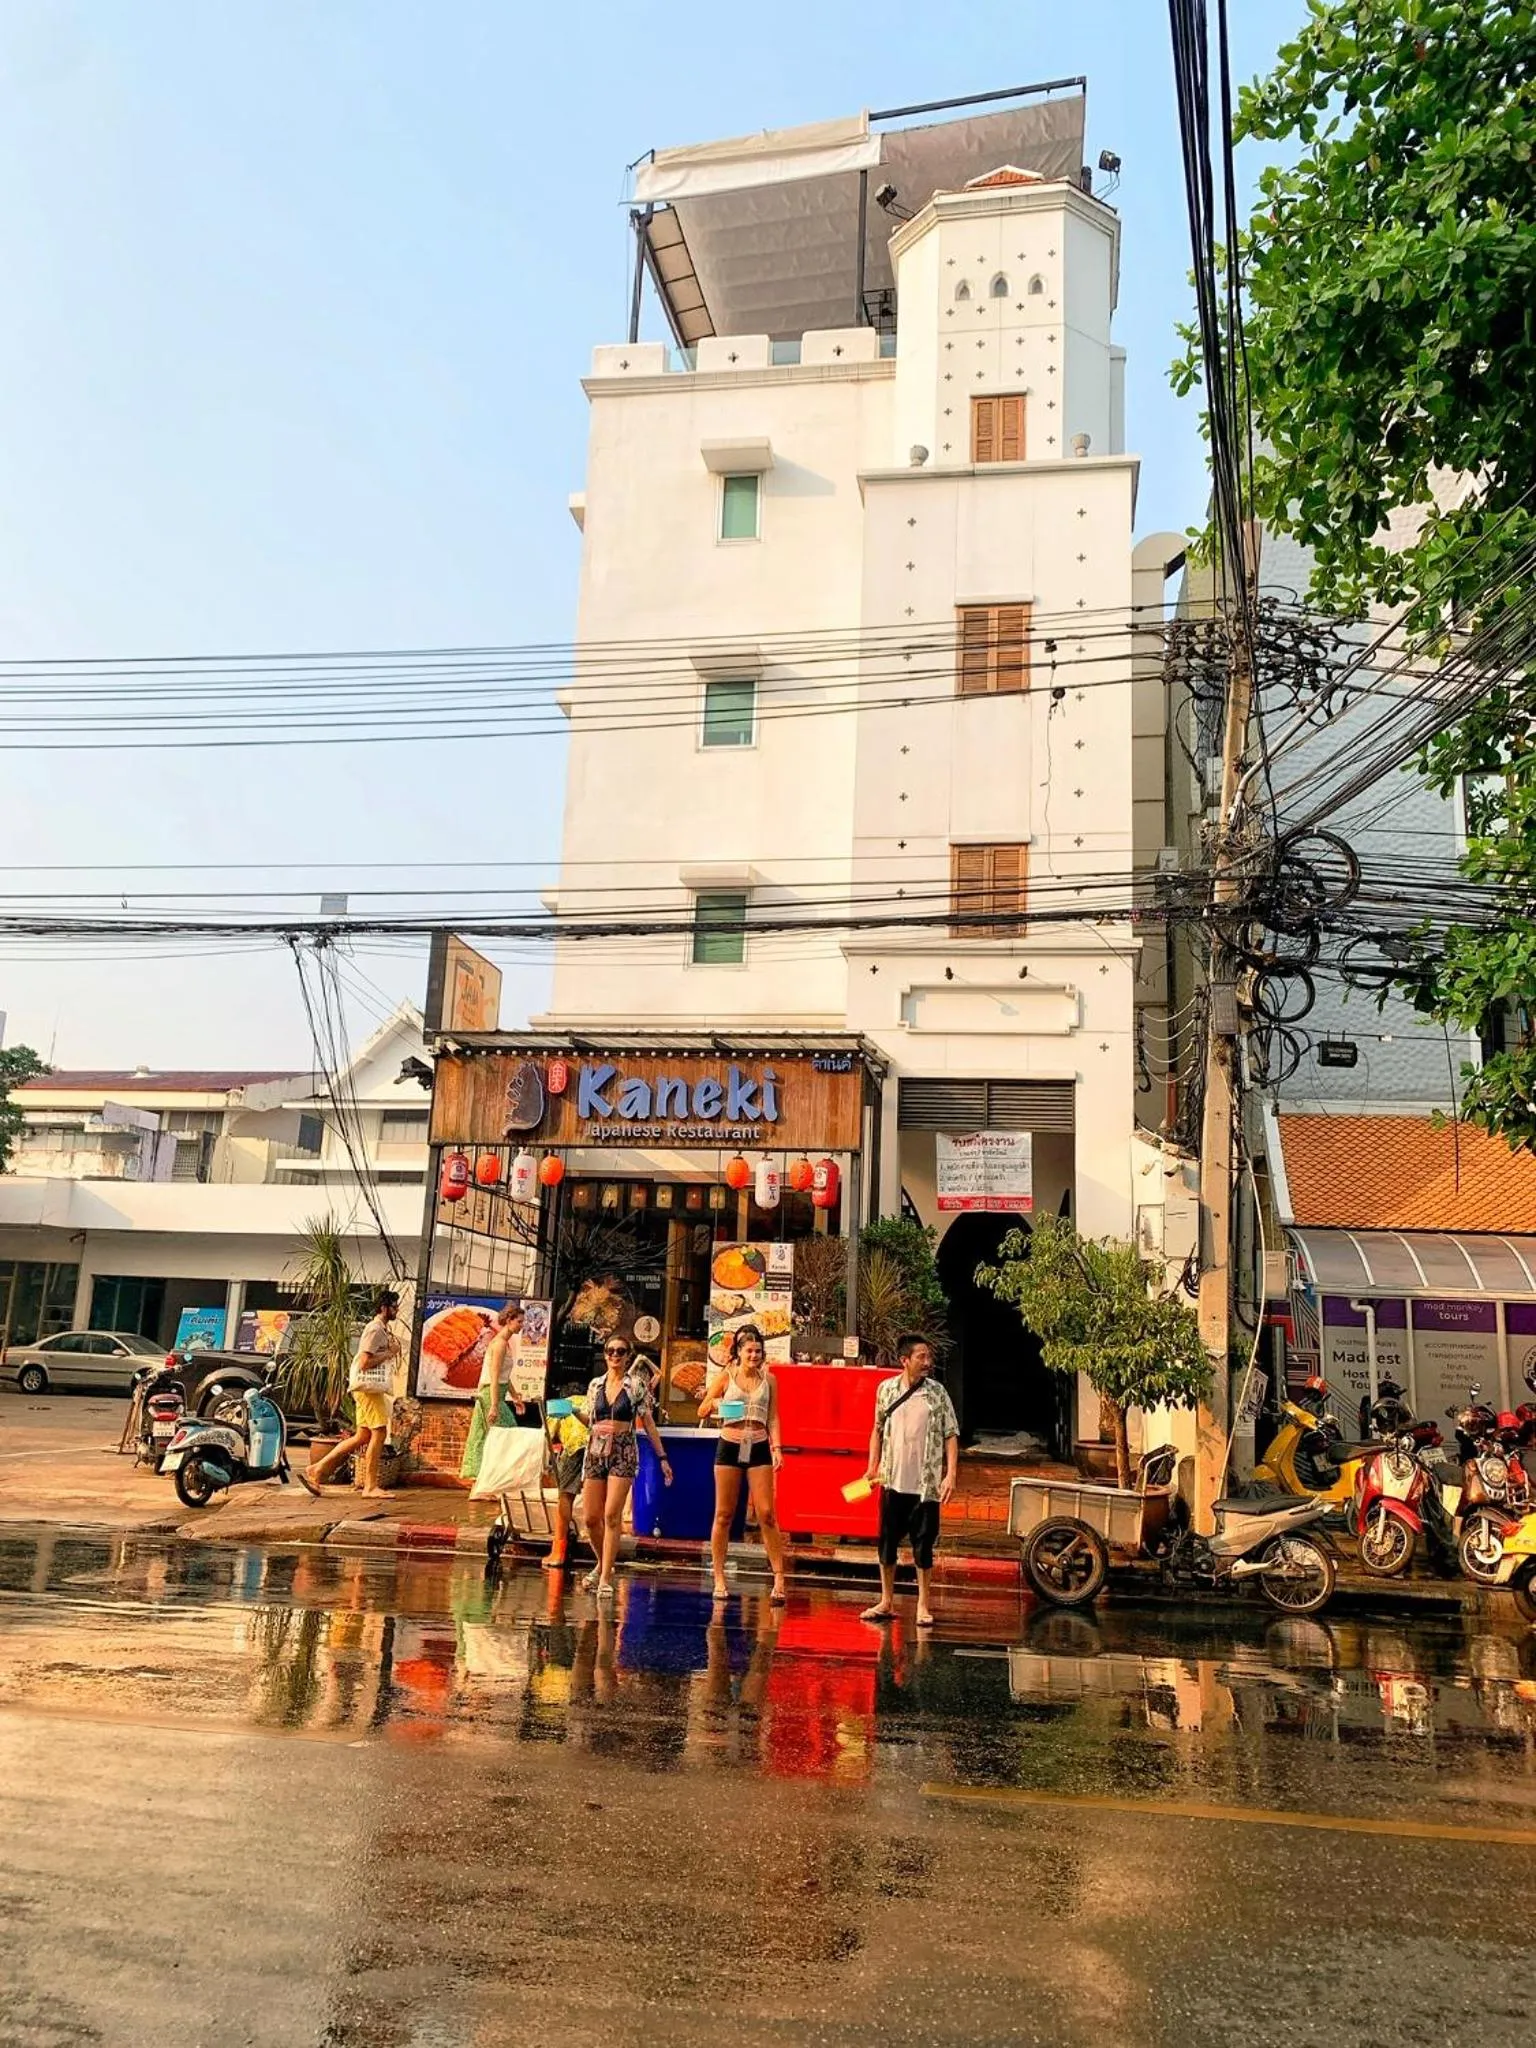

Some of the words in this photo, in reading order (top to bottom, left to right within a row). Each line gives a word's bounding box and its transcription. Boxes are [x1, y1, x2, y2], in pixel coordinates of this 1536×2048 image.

[578, 1063, 778, 1122] Kaneki
[585, 1122, 661, 1140] Japanese
[667, 1123, 761, 1140] Restaurant
[1439, 1312, 1469, 1321] tours
[1333, 1351, 1401, 1364] Madest
[1343, 1370, 1380, 1379] Hostl
[1384, 1371, 1392, 1379] &
